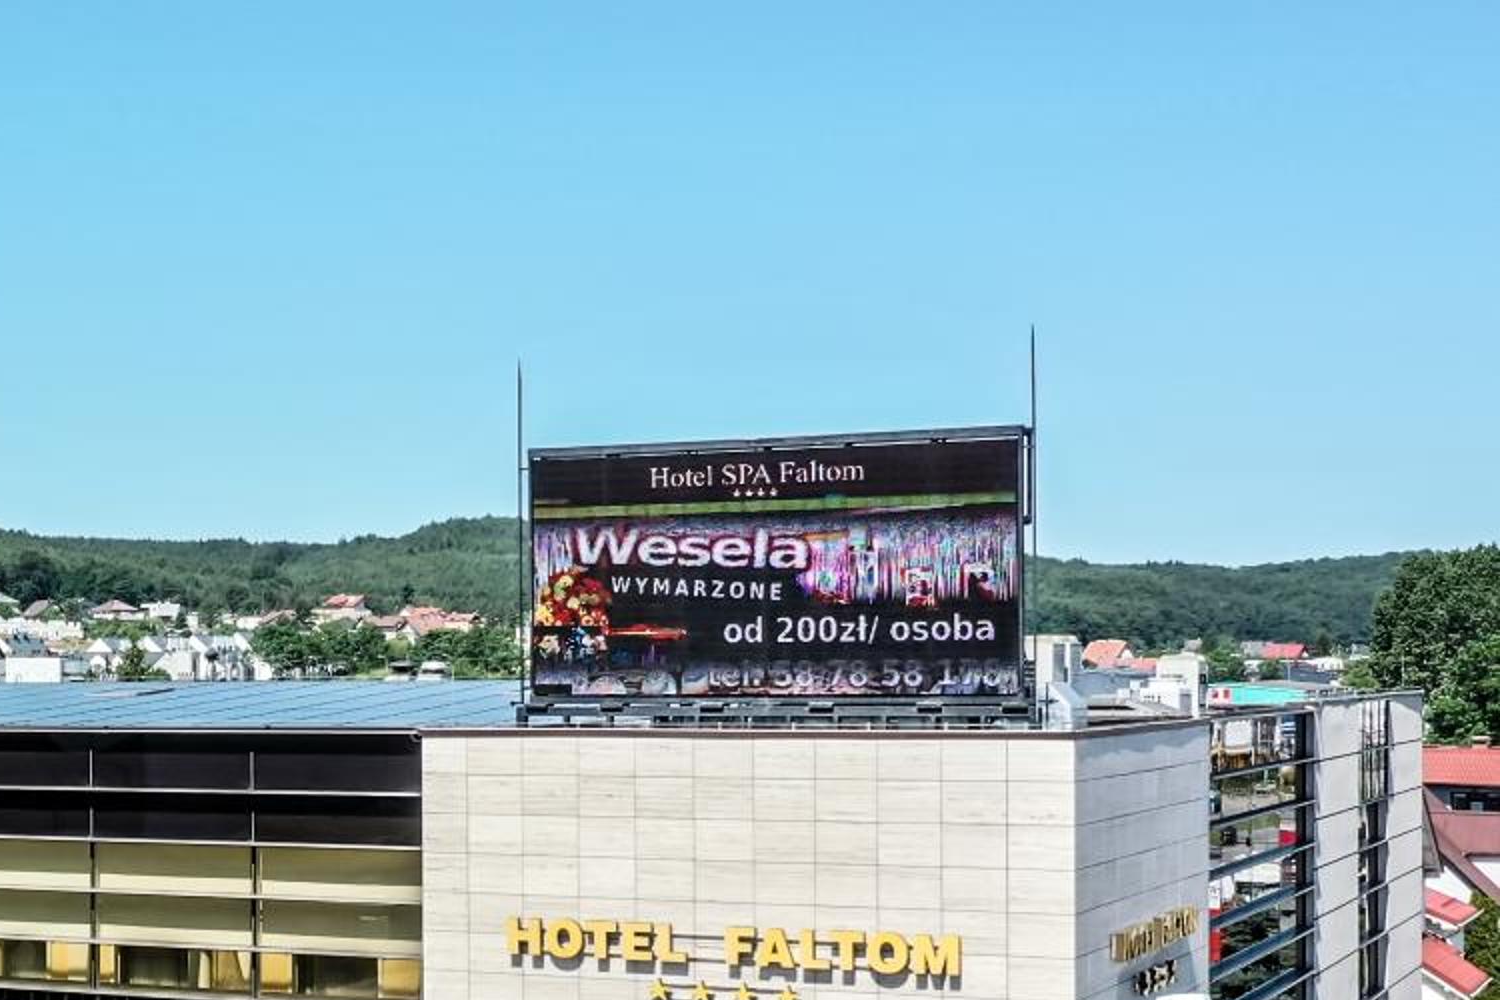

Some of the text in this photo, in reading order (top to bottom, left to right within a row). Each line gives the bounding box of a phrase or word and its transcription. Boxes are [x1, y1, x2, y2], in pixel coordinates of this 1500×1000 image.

[650, 460, 865, 488] Hotel SPA Faltom
[576, 527, 808, 569] Wesela
[611, 575, 783, 600] WYMARZONE
[724, 616, 763, 643] od
[890, 613, 995, 641] osoba
[882, 659, 922, 687] 58
[501, 915, 962, 976] HOTEL FALTOM
